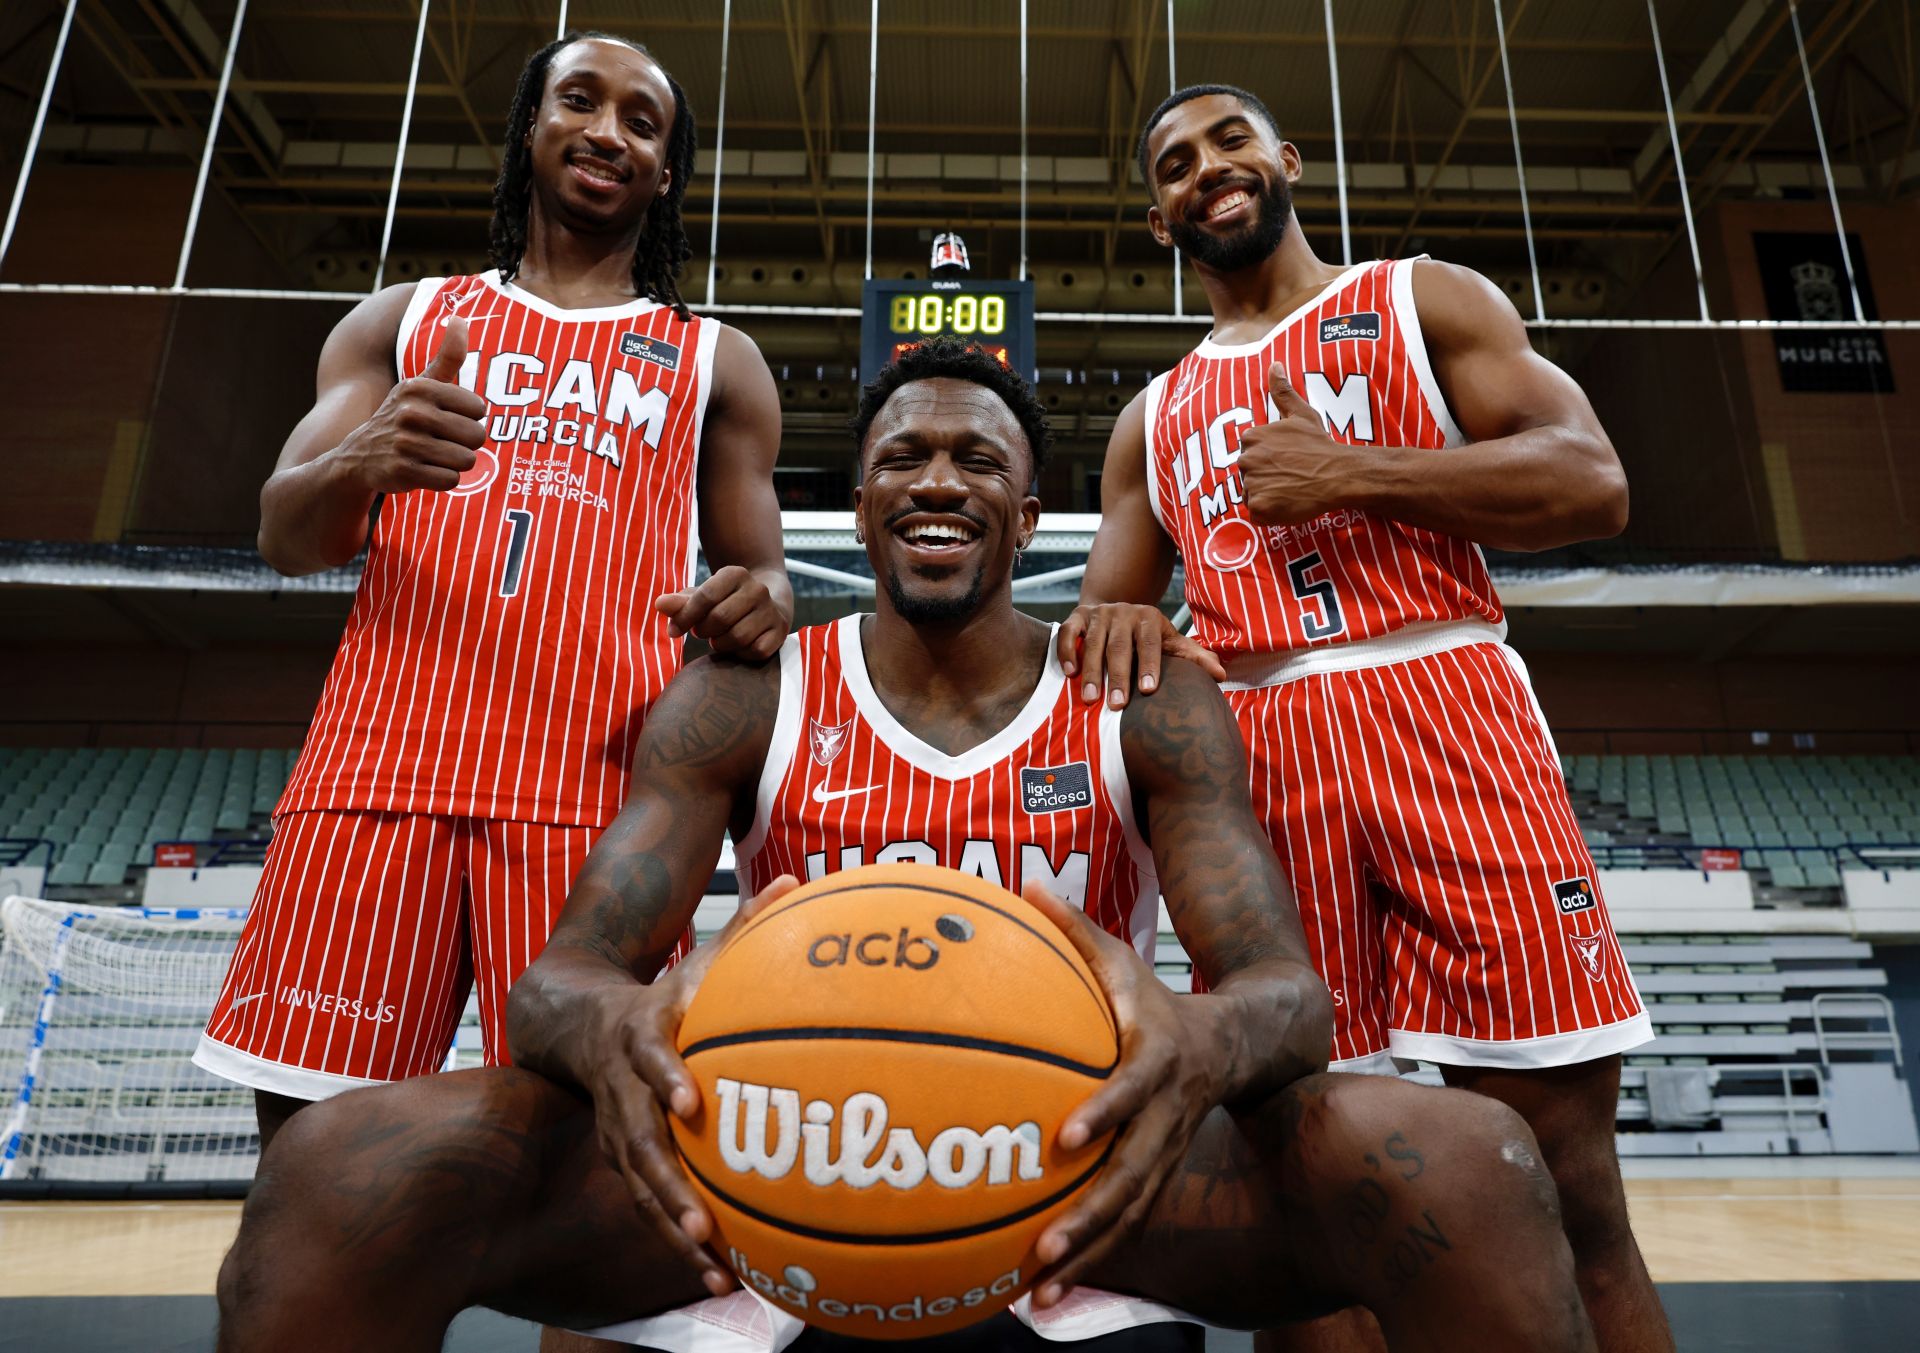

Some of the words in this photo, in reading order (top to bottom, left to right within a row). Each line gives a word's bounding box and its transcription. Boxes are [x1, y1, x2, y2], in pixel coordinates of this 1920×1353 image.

[905, 295, 1005, 333] 10:00
[1323, 323, 1348, 333] liga
[626, 339, 650, 351] liga
[1323, 328, 1376, 340] endesa
[625, 346, 674, 367] endesa
[484, 414, 622, 471] URCIA
[1170, 371, 1375, 508] UCM
[511, 467, 582, 487] REGIÓN
[515, 456, 541, 467] Costa
[507, 481, 533, 497] DE
[538, 483, 610, 512] MURCIA
[1270, 530, 1292, 550] DE
[1292, 509, 1365, 540] MURCIA
[498, 508, 534, 598] 1
[1286, 549, 1347, 640] 5
[1027, 782, 1054, 797] liga
[1028, 790, 1087, 807] endesa
[1562, 891, 1588, 910] acb
[807, 927, 940, 971] acb
[279, 985, 396, 1023] INVERSUS
[715, 1076, 1044, 1190] Wilson
[729, 1246, 809, 1309] liga
[816, 1267, 1021, 1322] endesa
